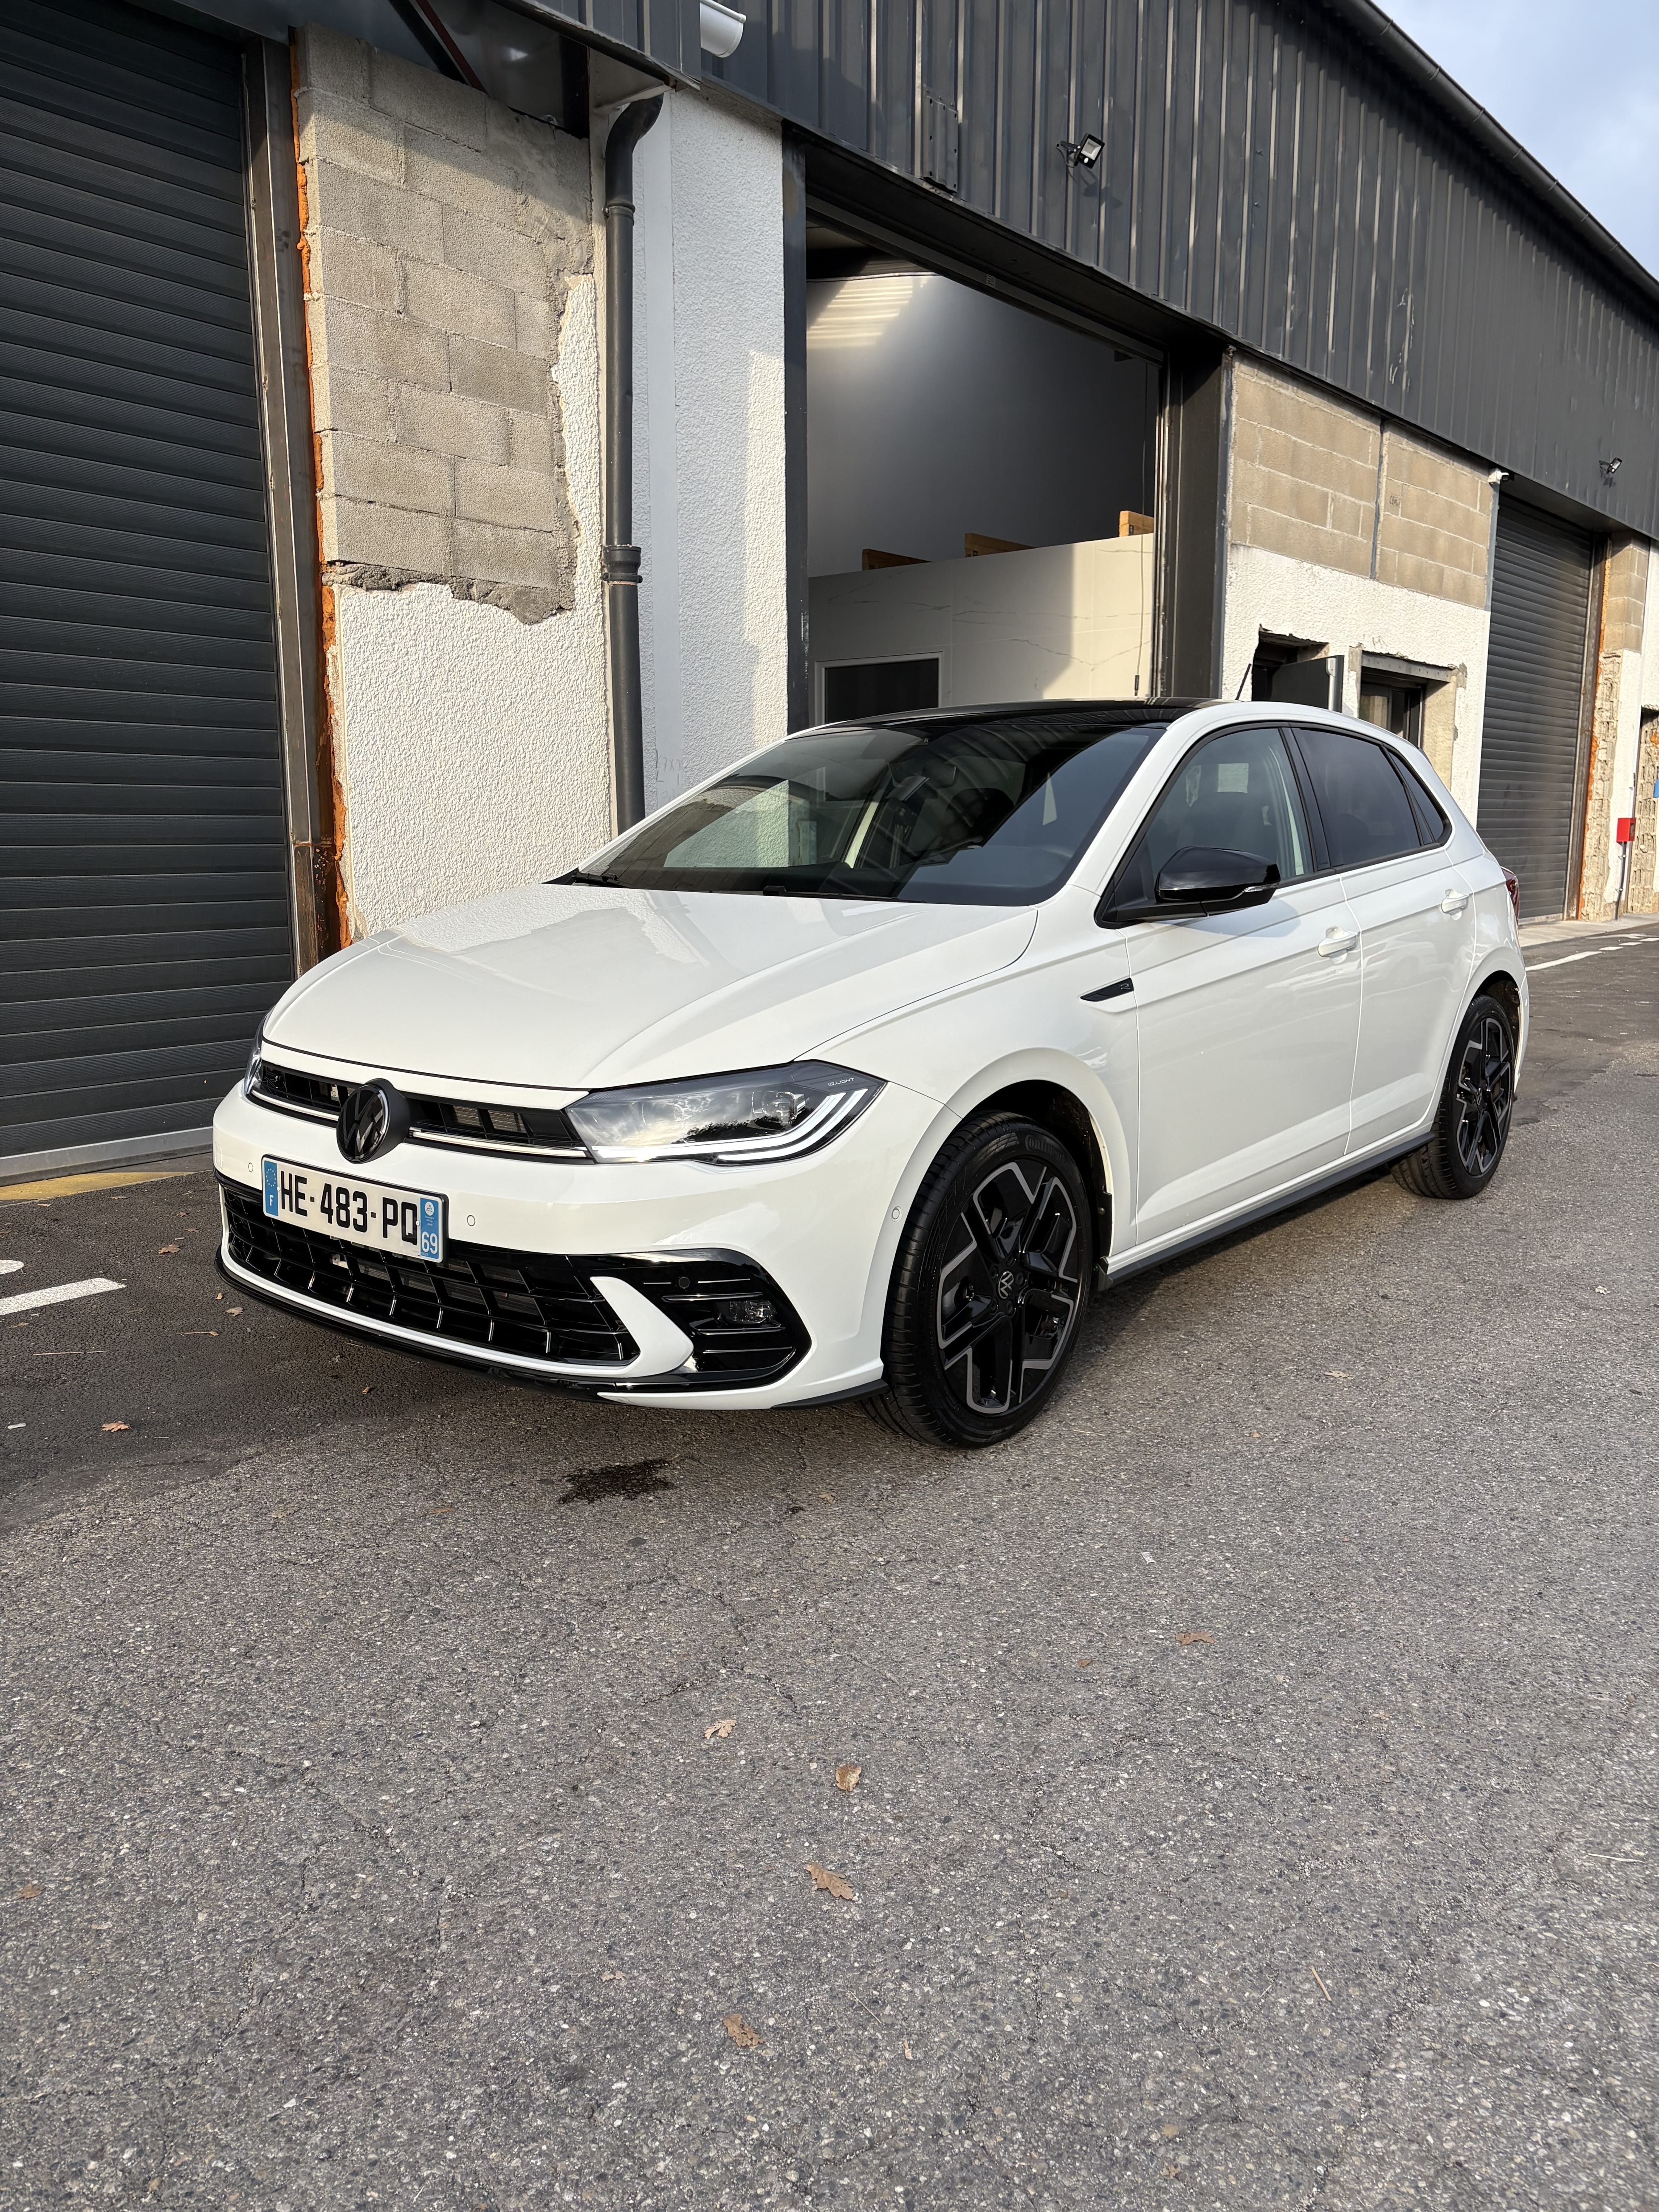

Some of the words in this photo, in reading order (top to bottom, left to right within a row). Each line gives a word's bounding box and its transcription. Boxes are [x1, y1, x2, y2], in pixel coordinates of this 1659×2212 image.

[828, 1077, 855, 1087] IQ.LIGHT
[269, 1194, 274, 1206] F
[280, 1170, 417, 1246] HE-483-PQ
[421, 1231, 438, 1254] 69
